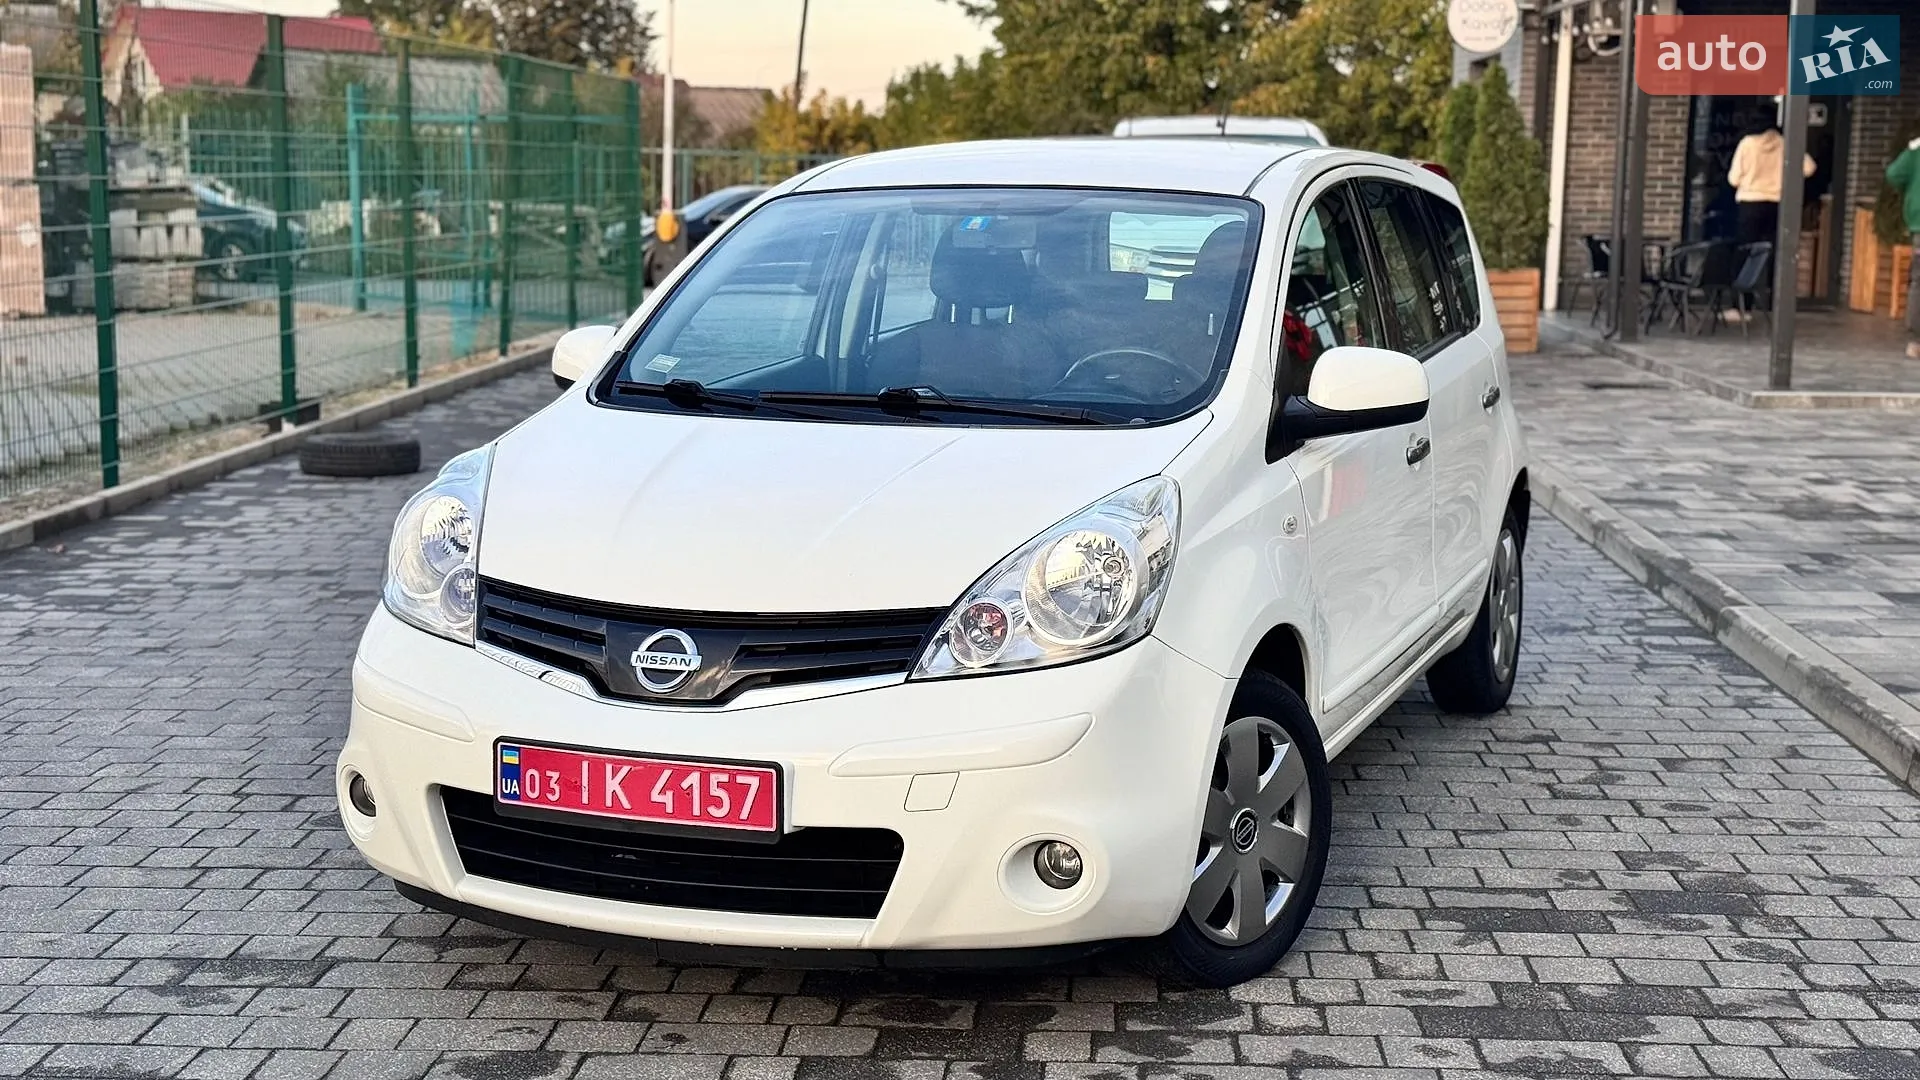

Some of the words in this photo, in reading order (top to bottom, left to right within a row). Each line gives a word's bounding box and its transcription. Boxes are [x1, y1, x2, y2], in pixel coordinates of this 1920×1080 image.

[635, 654, 692, 667] NISSAN
[502, 778, 520, 795] UA
[525, 768, 560, 801] 03
[651, 769, 760, 820] 4157
